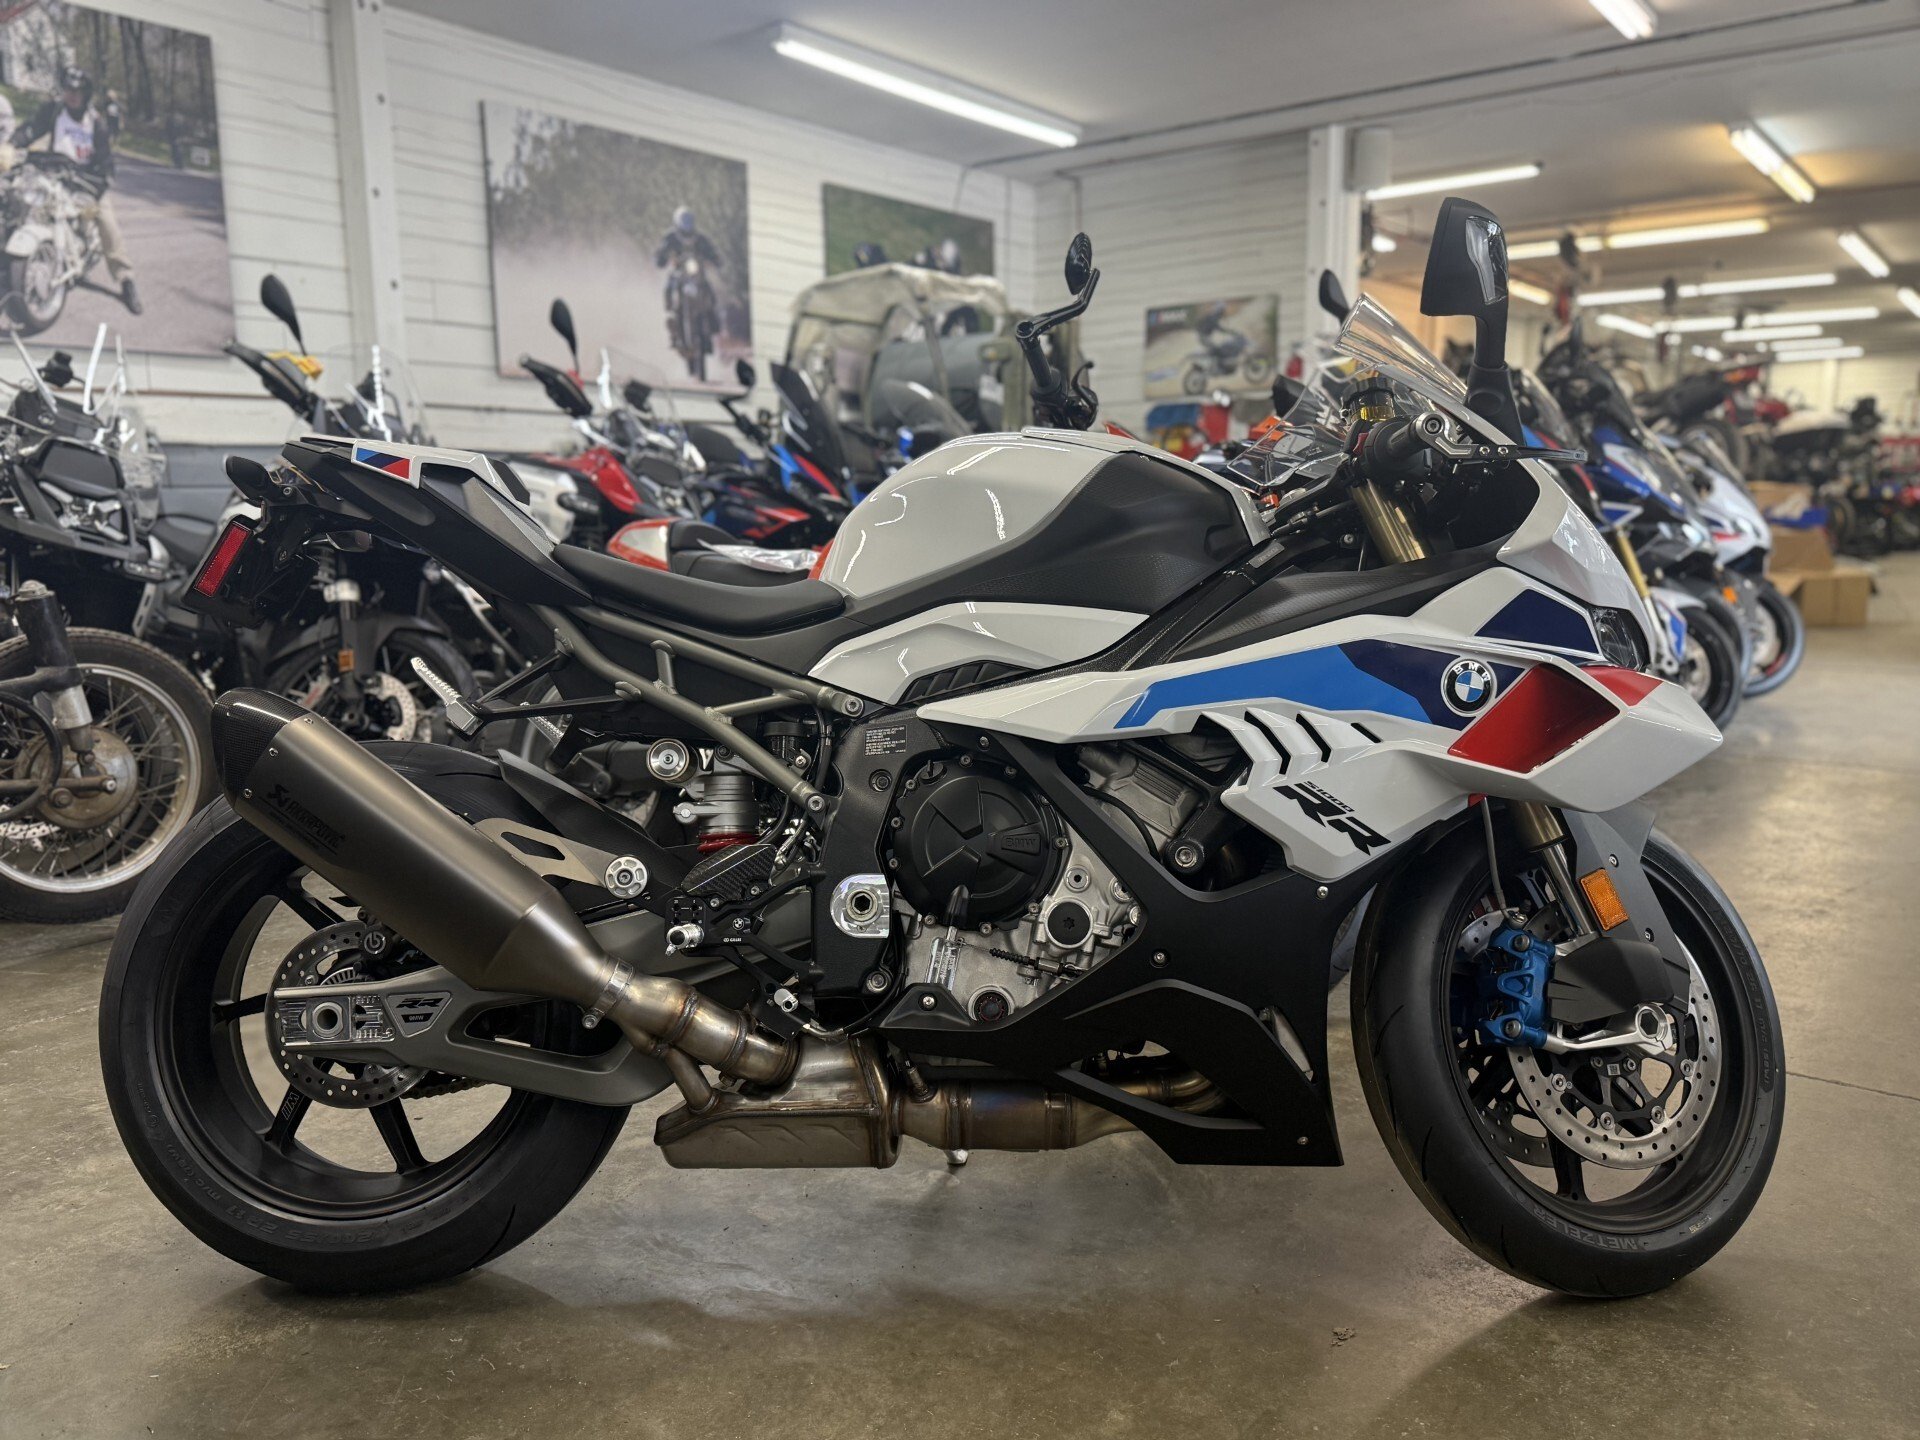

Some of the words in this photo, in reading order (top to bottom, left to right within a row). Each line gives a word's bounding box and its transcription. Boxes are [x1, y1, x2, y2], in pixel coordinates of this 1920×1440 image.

[1304, 780, 1355, 813] S1000
[1272, 782, 1392, 856] RR
[1006, 837, 1036, 849] BMW
[1533, 1204, 1640, 1250] METZELER
